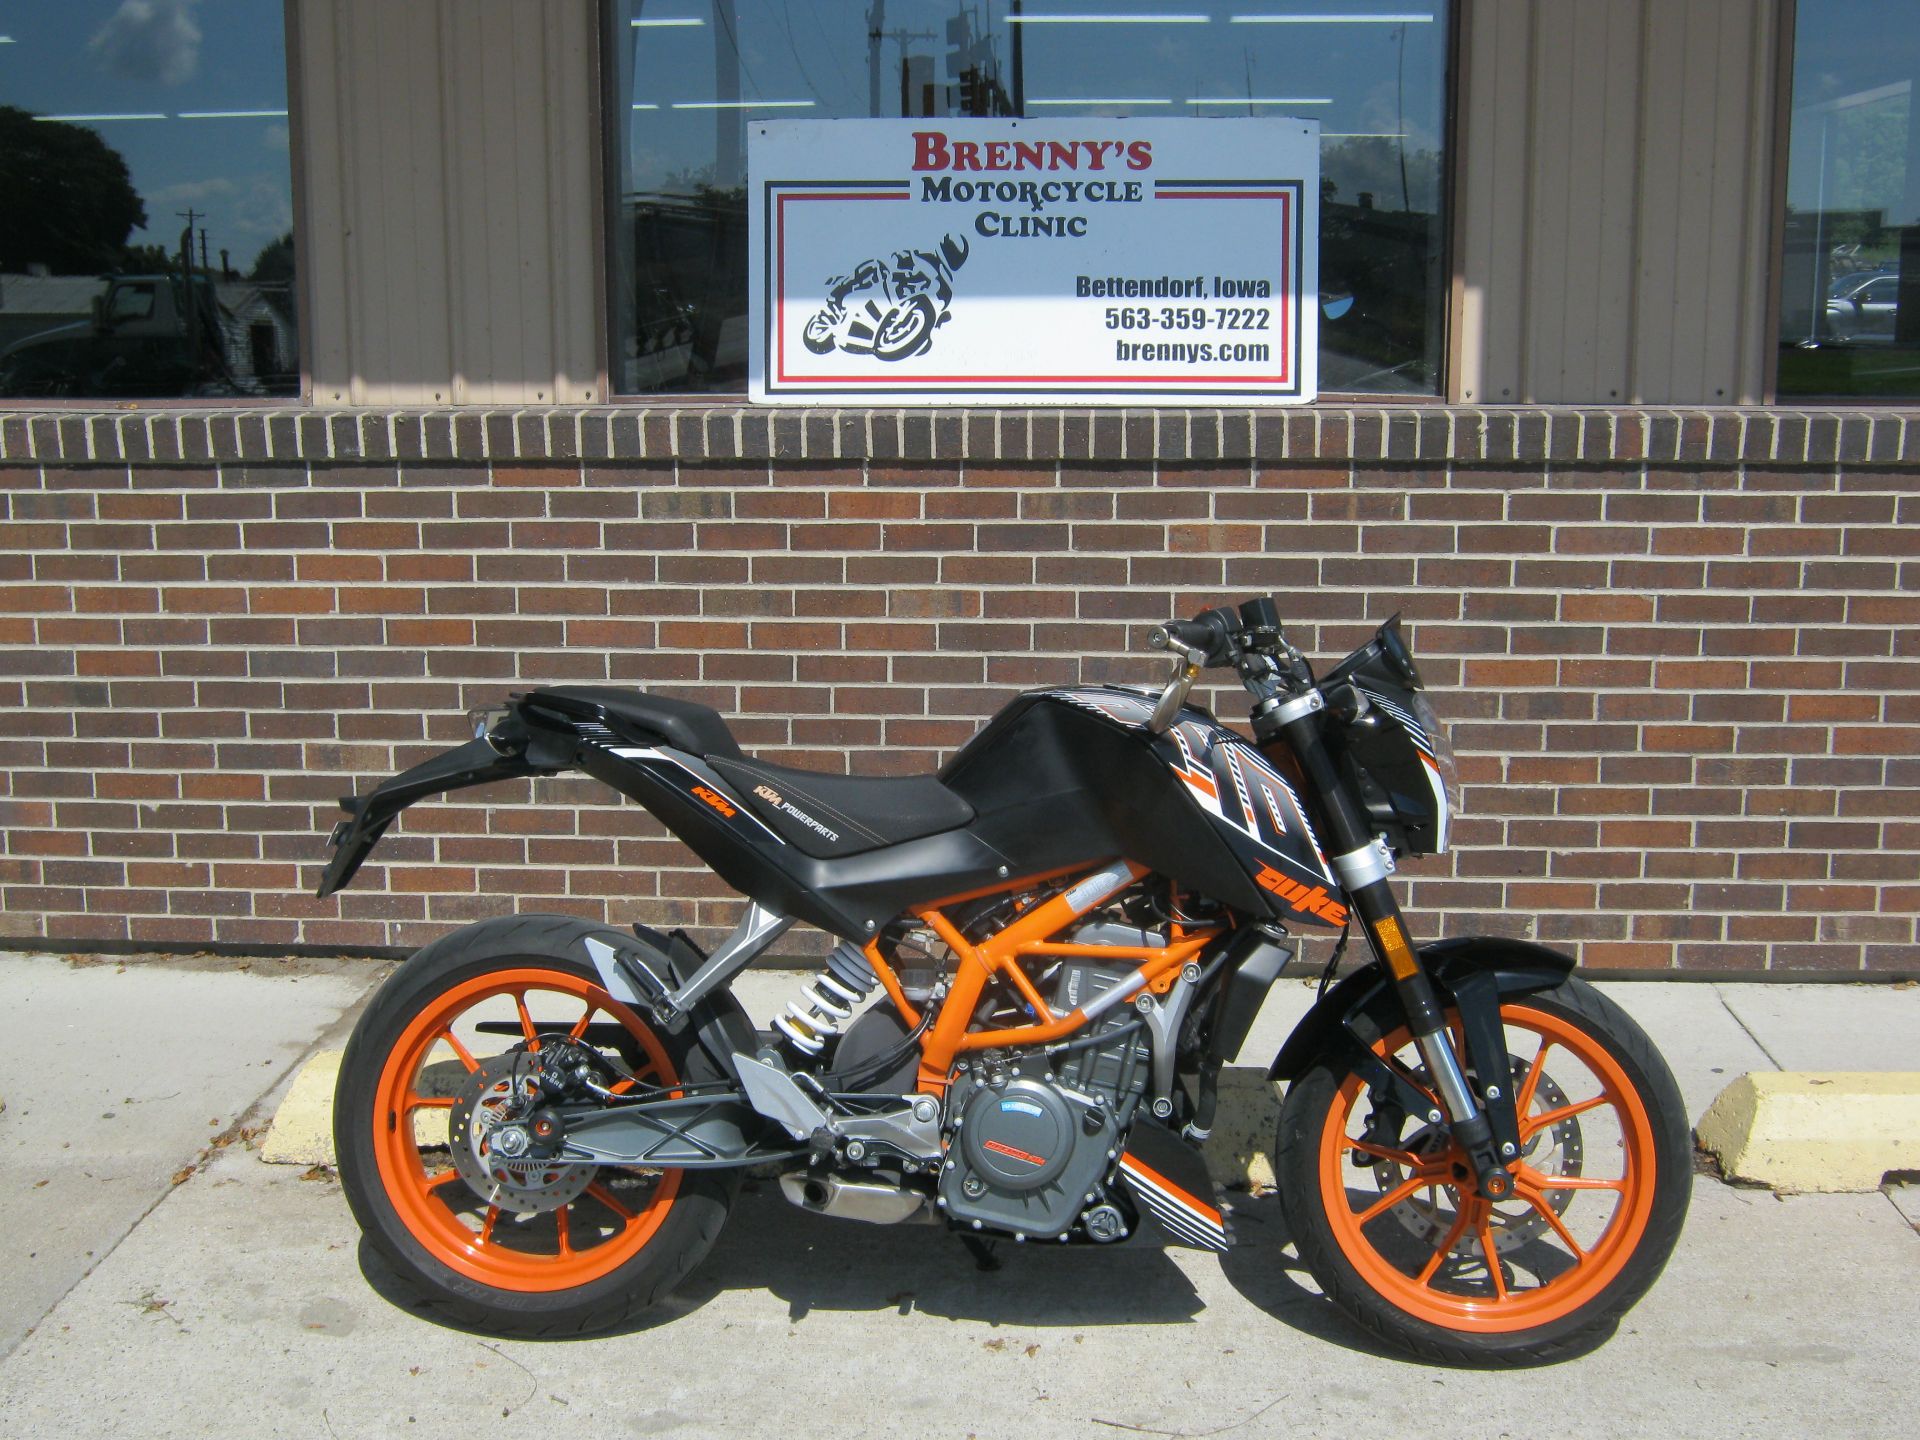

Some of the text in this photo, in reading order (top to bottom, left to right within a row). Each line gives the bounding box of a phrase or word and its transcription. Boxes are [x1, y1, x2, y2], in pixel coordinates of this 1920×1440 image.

[913, 132, 1152, 170] BRENNY'S
[922, 177, 1143, 212] MOTORCYCLE
[975, 212, 1088, 238] CLINIC
[1076, 276, 1271, 299] Bettendorf, Iowa
[1105, 308, 1270, 330] 563-359-7222
[1116, 340, 1270, 363] brennys.com
[691, 786, 735, 818] KTM
[753, 786, 782, 806] KTM
